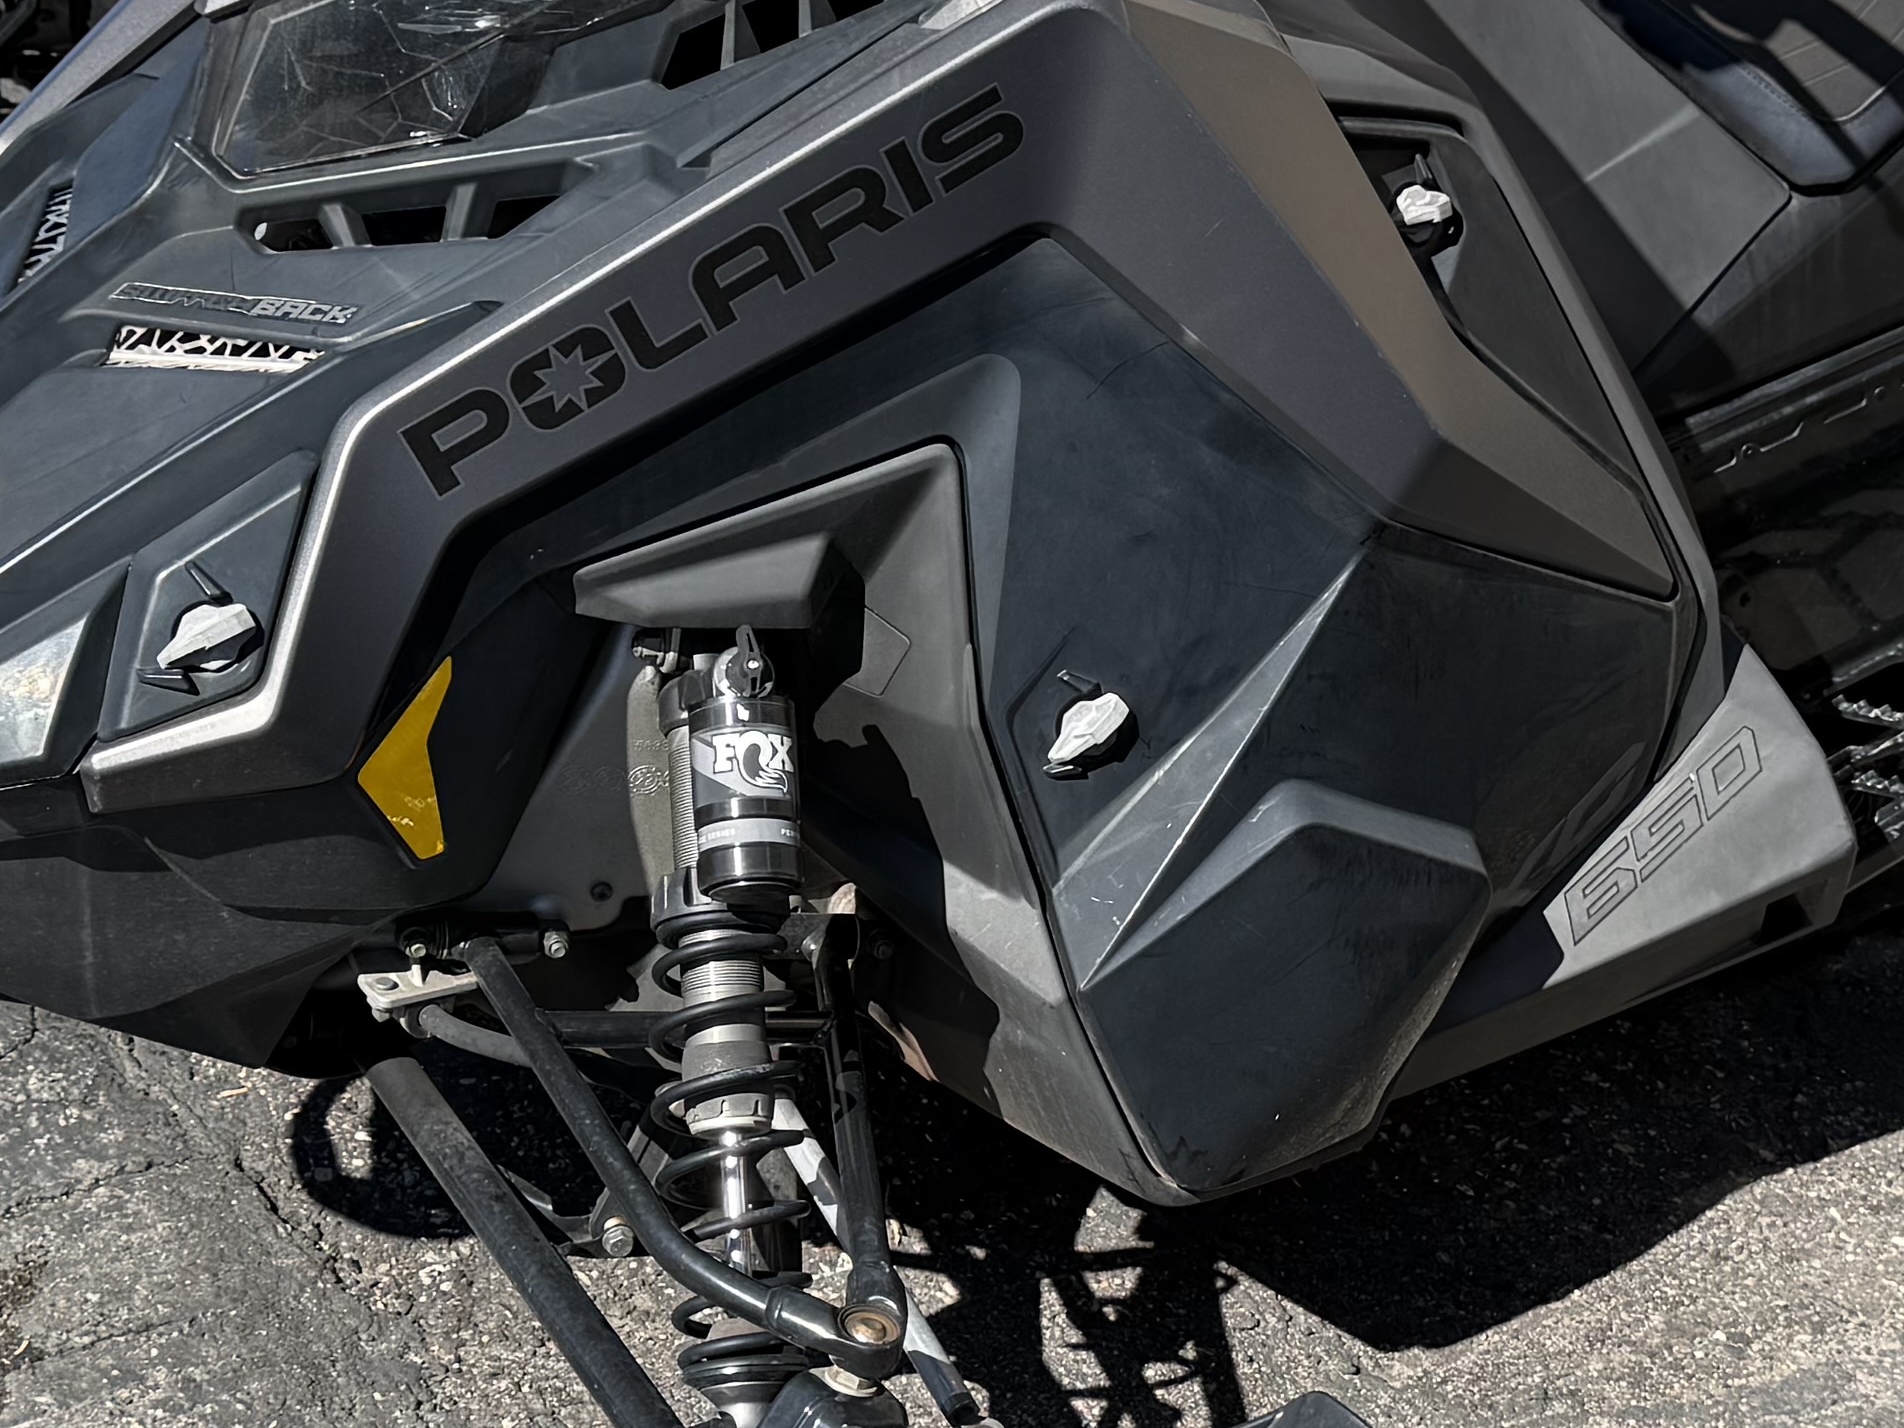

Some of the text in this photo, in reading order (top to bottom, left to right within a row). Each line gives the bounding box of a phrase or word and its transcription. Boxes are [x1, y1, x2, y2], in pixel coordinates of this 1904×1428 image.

[397, 82, 1026, 499] POLARIS
[711, 729, 795, 794] FOX
[1562, 725, 1763, 946] 650
